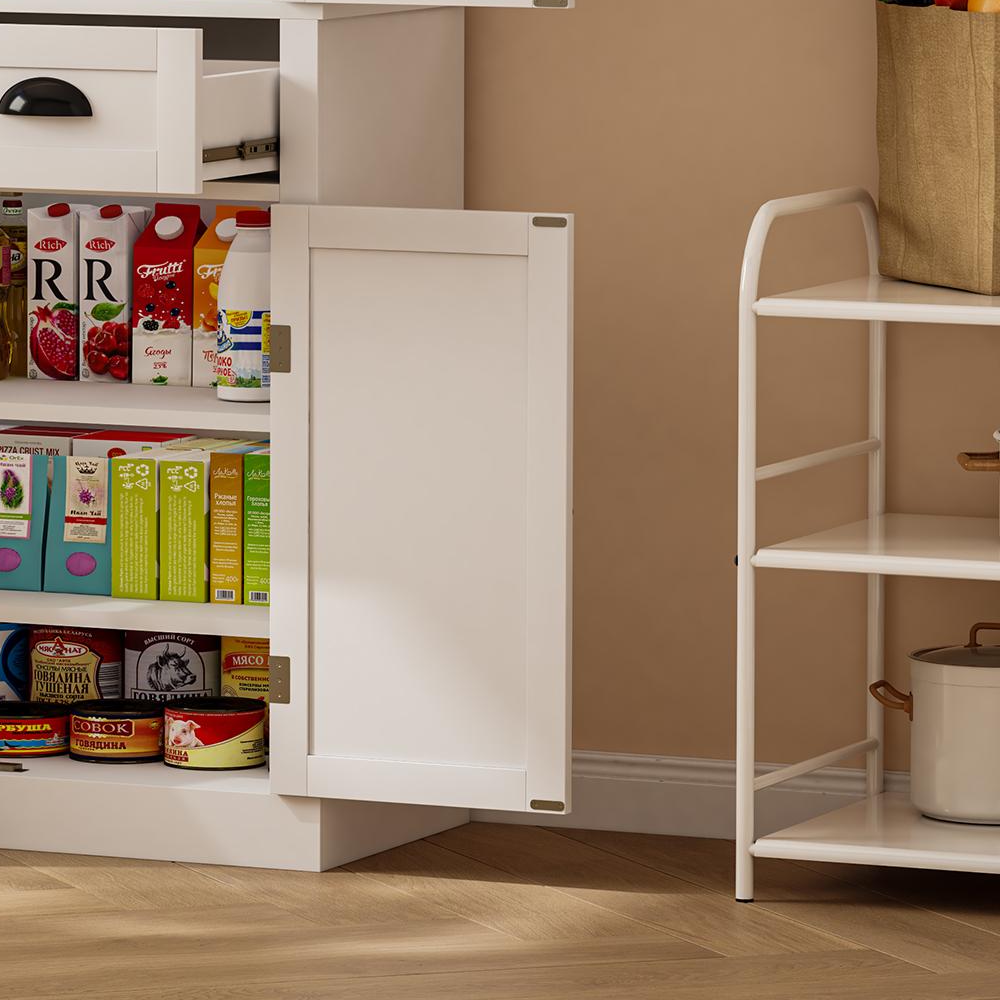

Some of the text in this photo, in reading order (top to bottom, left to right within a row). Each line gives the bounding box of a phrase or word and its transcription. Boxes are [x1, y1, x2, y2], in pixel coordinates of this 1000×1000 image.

[40, 240, 62, 250] Rich
[90, 240, 111, 250] Rich
[137, 261, 184, 278] Frutti
[32, 258, 68, 301] R
[84, 258, 118, 302] R
[20, 446, 44, 455] CRUST
[46, 448, 60, 456] MIX
[144, 634, 195, 645] ВЫСШИЙ СОРТ
[232, 655, 264, 665] МЯСО
[34, 670, 91, 683] ГОВЯДИНА
[36, 681, 89, 694] ТУШЕНАЯ
[74, 720, 130, 734] СОВОК
[76, 739, 126, 750] ГОВЯДИНА
